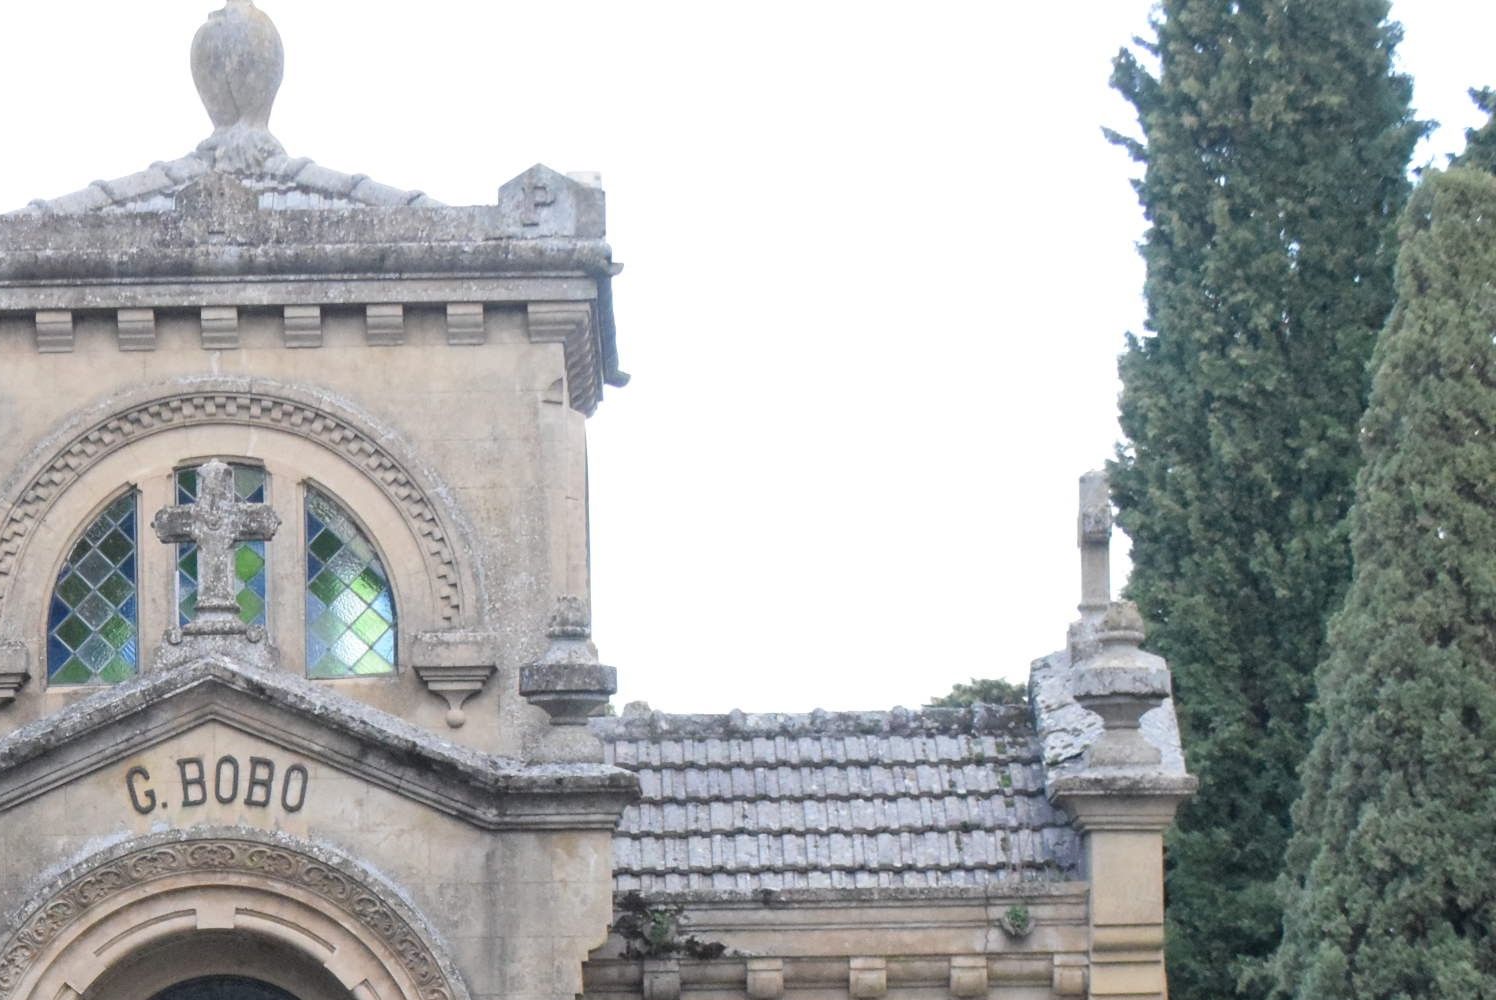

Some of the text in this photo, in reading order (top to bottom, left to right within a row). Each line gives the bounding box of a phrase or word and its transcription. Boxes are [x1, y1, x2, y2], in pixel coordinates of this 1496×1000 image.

[521, 181, 557, 227] P
[125, 754, 309, 815] G. BOBO
